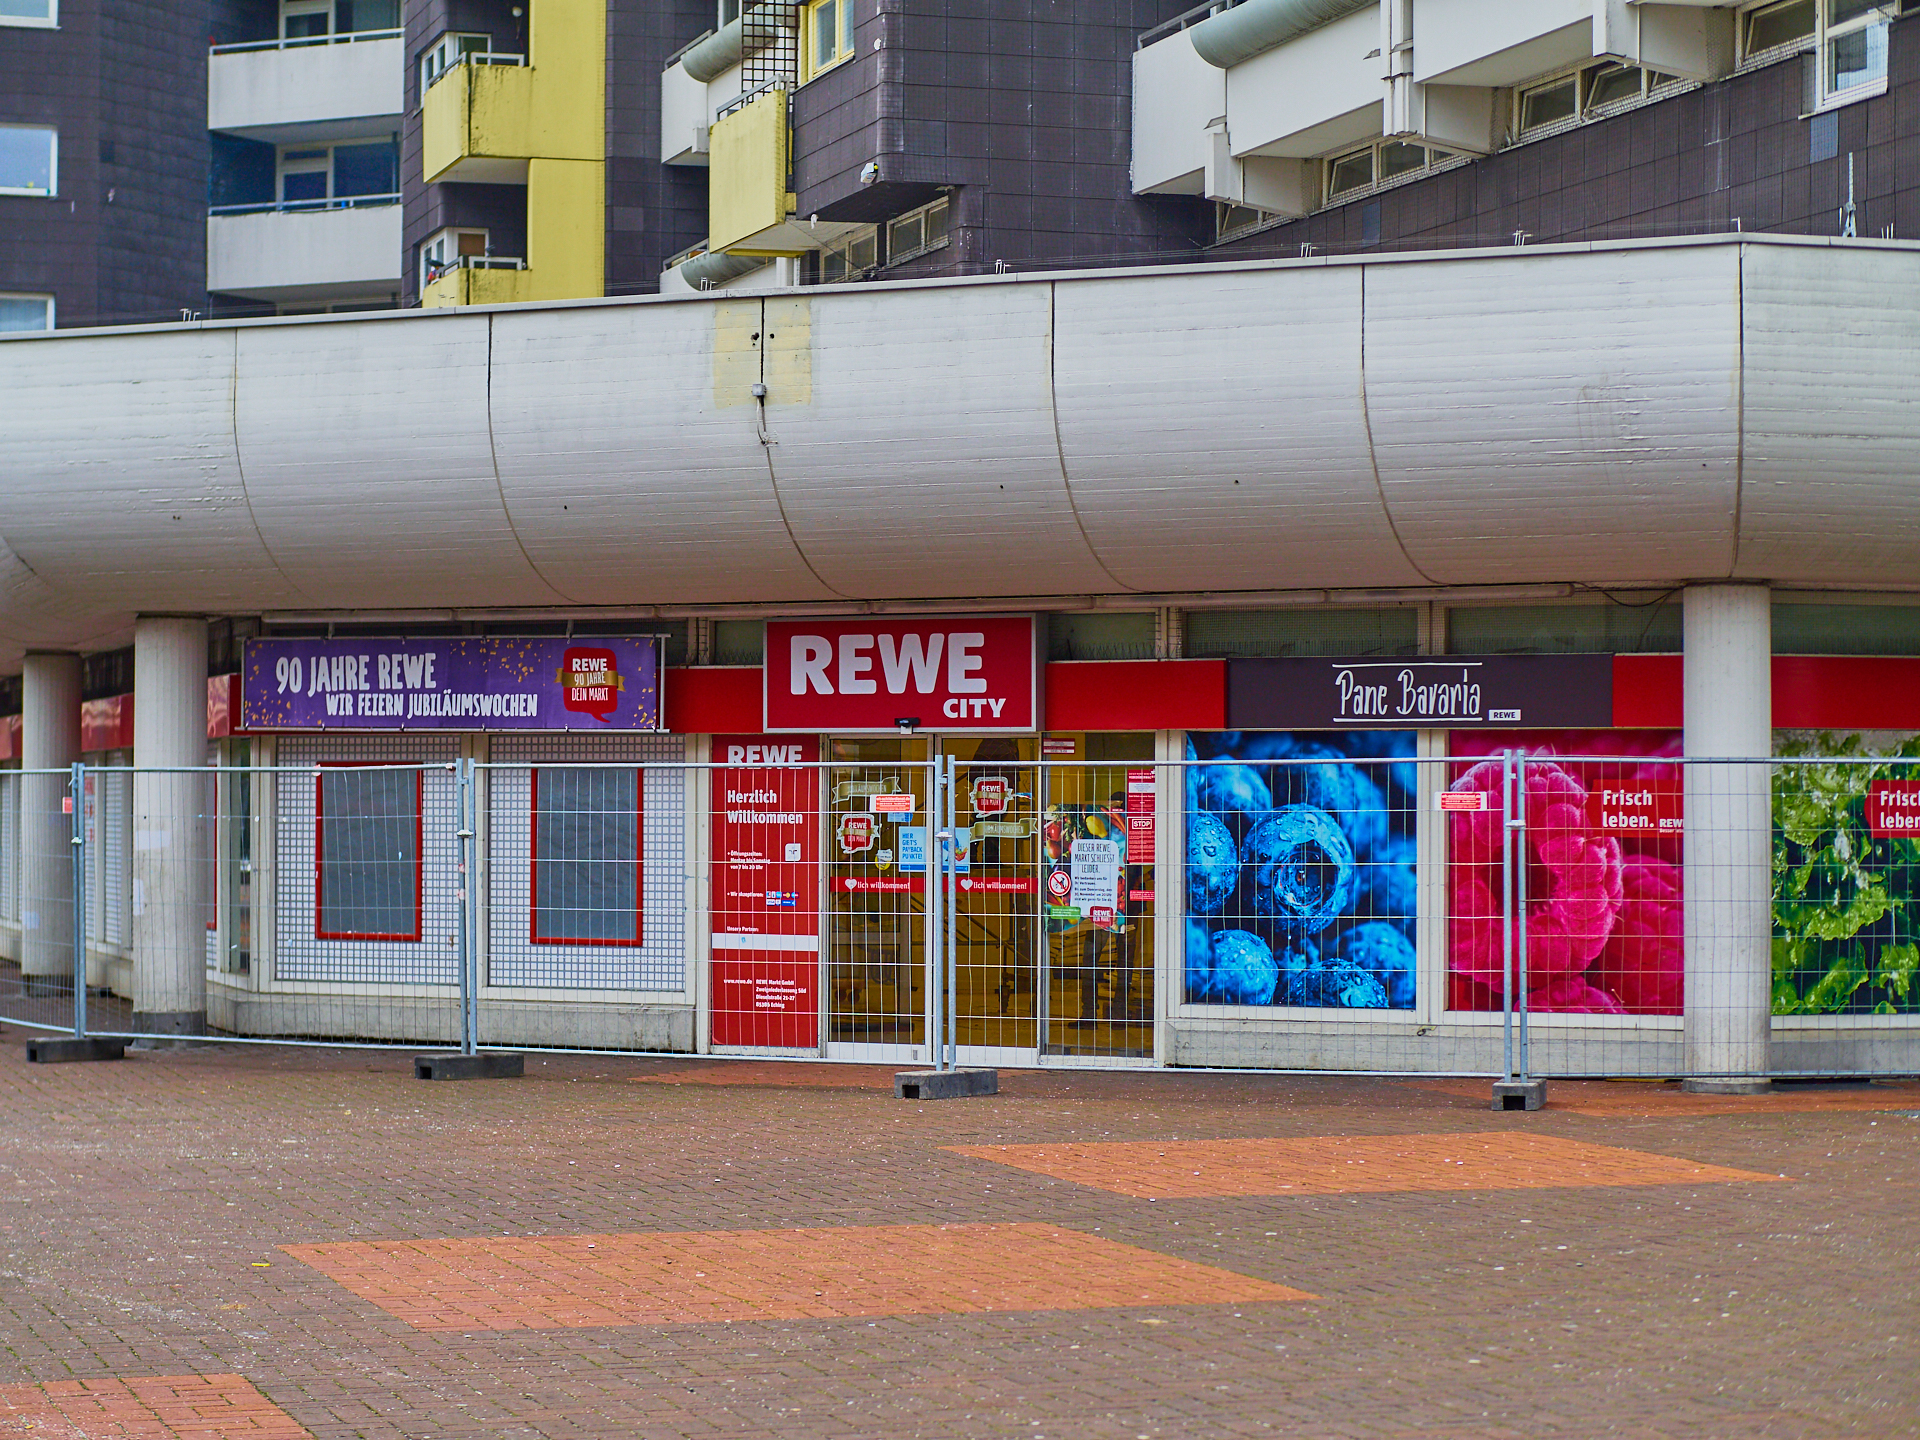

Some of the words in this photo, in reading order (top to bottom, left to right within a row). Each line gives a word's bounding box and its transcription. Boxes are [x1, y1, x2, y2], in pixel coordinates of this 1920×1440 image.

[572, 658, 608, 672] REWE
[790, 632, 987, 695] REWE
[276, 657, 302, 694] 90
[308, 655, 370, 697] JAHRE
[378, 653, 436, 690] REWE
[574, 674, 584, 686] 90
[586, 672, 606, 686] JAHRE
[572, 688, 587, 701] DEIN
[589, 688, 608, 701] MARKT
[1335, 670, 1388, 716] Pane
[1396, 668, 1480, 715] Bavaria
[326, 693, 354, 716] WIR
[358, 692, 403, 716] FEIERN
[407, 689, 538, 719] JUBILÄUMSWOCHEN
[943, 698, 1006, 718] CITY
[728, 745, 803, 769] REWE
[728, 790, 777, 803] Herzlich
[1603, 790, 1652, 806] Frisch
[1880, 790, 1920, 806] Frisc
[727, 810, 802, 824] Willkommen
[1602, 811, 1654, 828] leben.
[1660, 818, 1684, 828] REW
[1078, 843, 1094, 852] DIESER
[1096, 844, 1110, 852] REWE
[1075, 854, 1089, 862] MARKT
[1091, 854, 1114, 863] SCHLIESST
